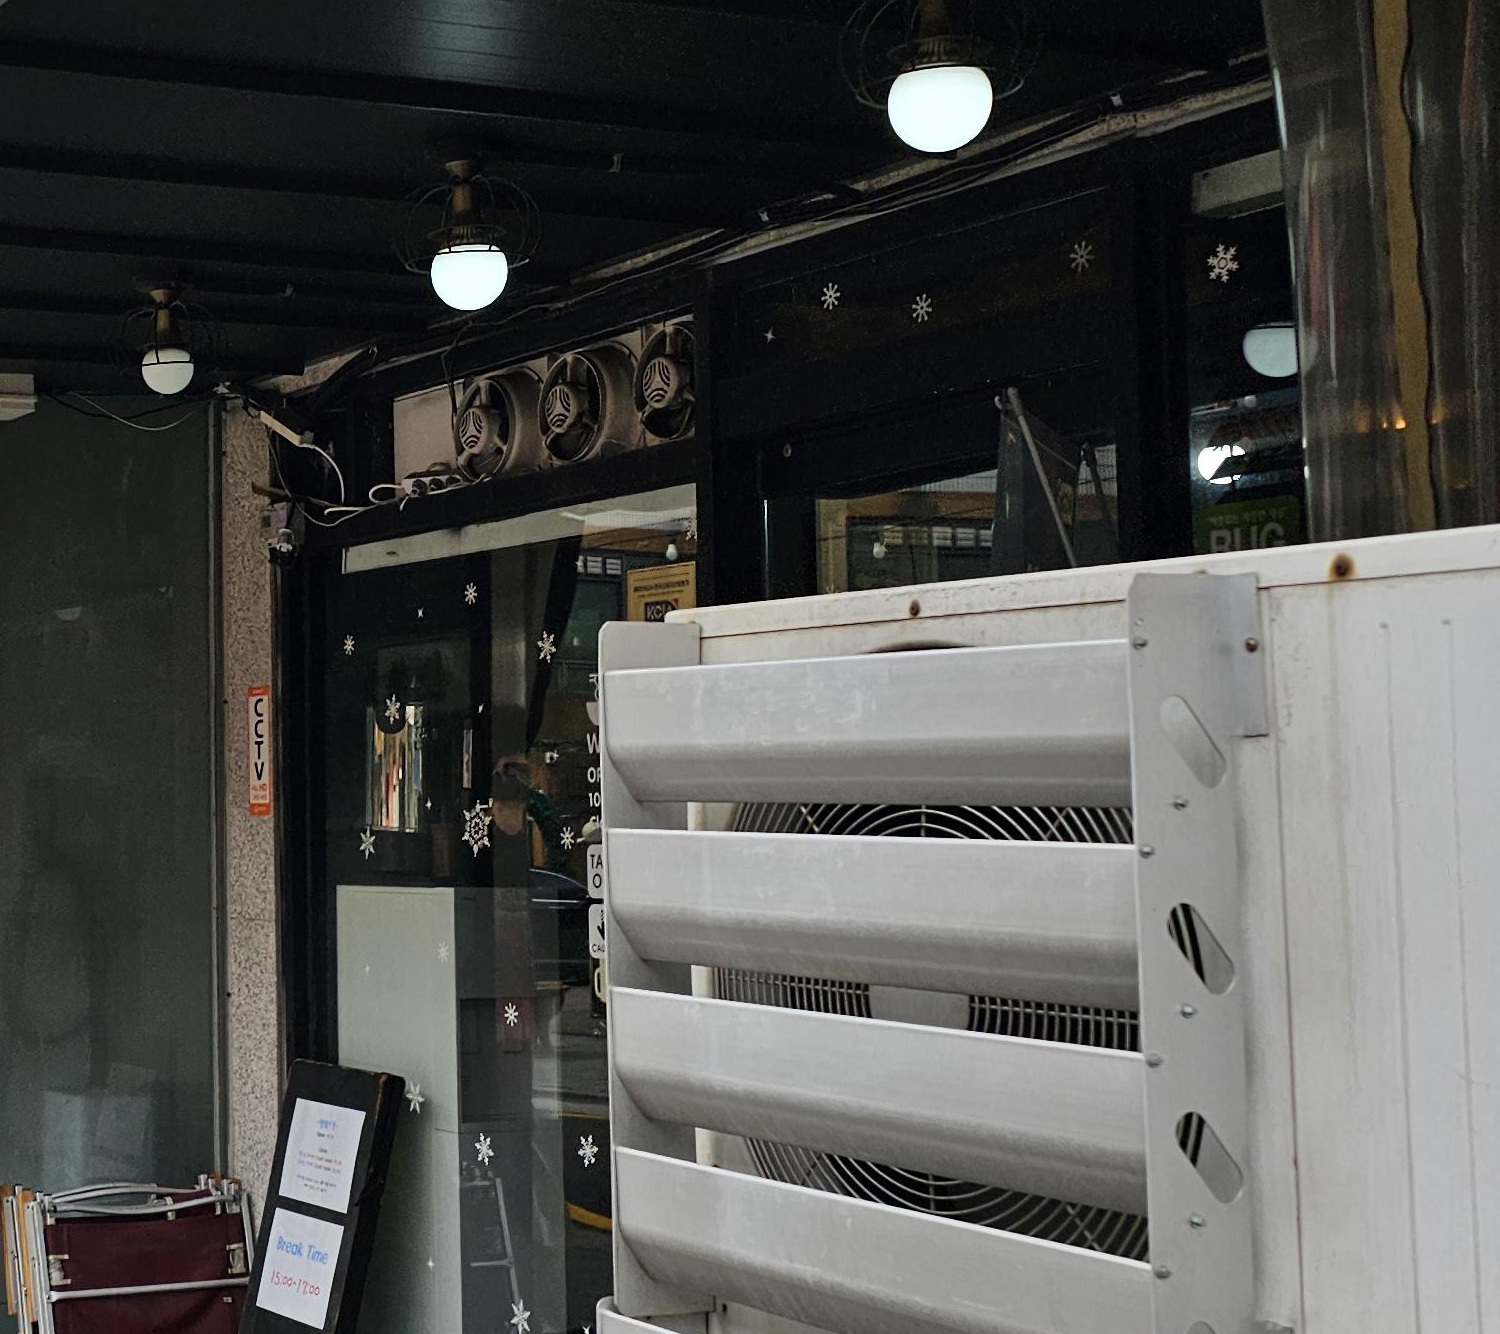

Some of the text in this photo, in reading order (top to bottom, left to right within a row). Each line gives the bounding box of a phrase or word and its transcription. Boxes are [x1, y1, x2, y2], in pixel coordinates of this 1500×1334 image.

[254, 697, 265, 782] CCTV
[276, 1235, 330, 1266] Break Time
